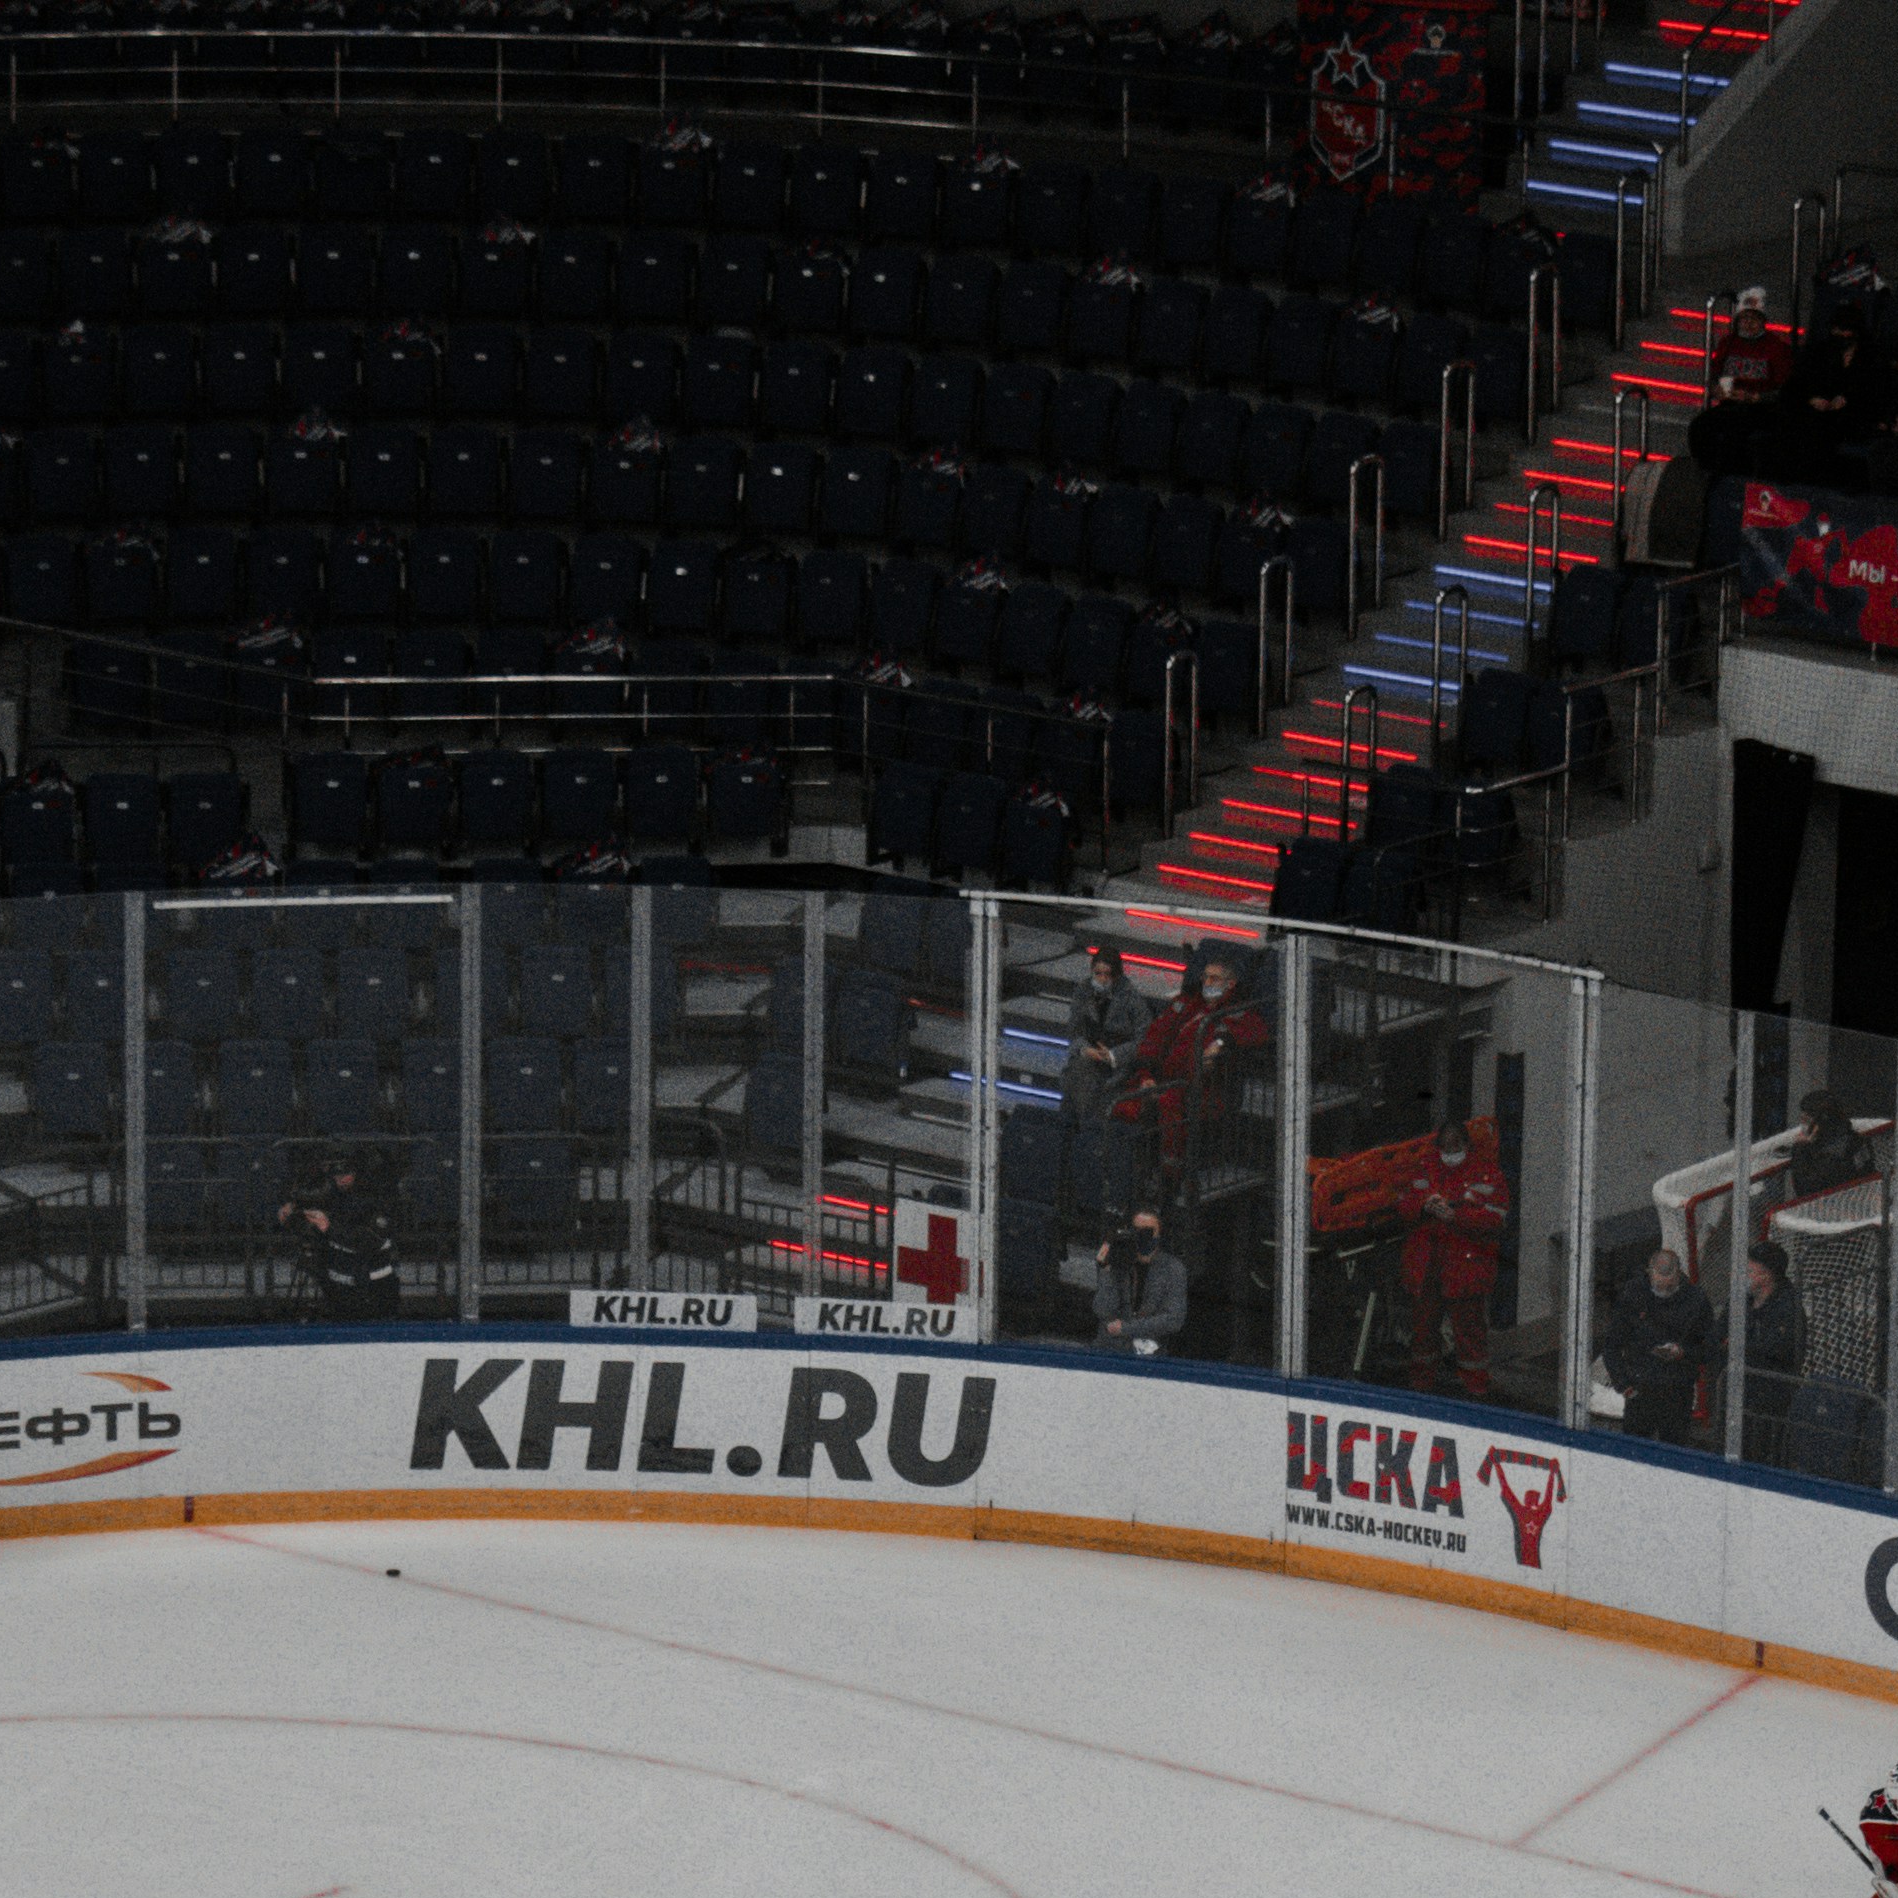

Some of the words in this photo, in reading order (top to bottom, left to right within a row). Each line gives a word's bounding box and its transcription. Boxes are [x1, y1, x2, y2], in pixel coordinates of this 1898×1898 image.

[1848, 558, 1886, 584] МЫ
[592, 1294, 733, 1327] KHL.RU
[816, 1301, 957, 1338] KHL.RU
[409, 1357, 997, 1487] KHL.RU
[1287, 1411, 1466, 1520] ЦСКА
[1286, 1503, 1468, 1554] WWW.CSKA-HOCKEY.RU
